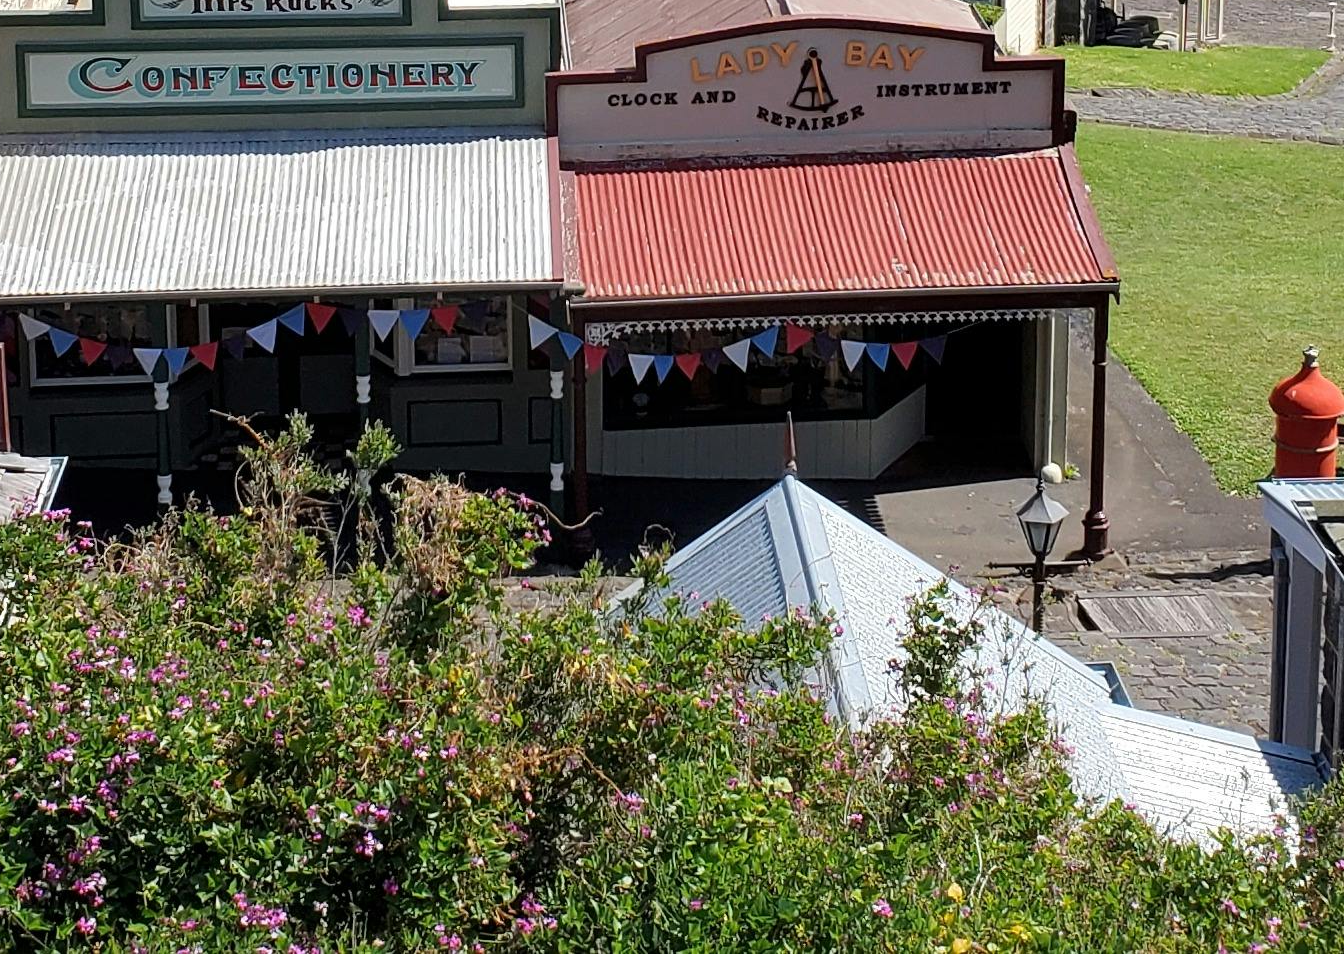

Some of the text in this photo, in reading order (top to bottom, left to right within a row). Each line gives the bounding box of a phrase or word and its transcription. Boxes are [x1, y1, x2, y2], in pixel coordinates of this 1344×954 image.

[690, 41, 926, 83] LADY BAY
[607, 80, 1012, 107] CLOCK AND INSTRUMENT
[756, 104, 865, 131] REPAIRER
